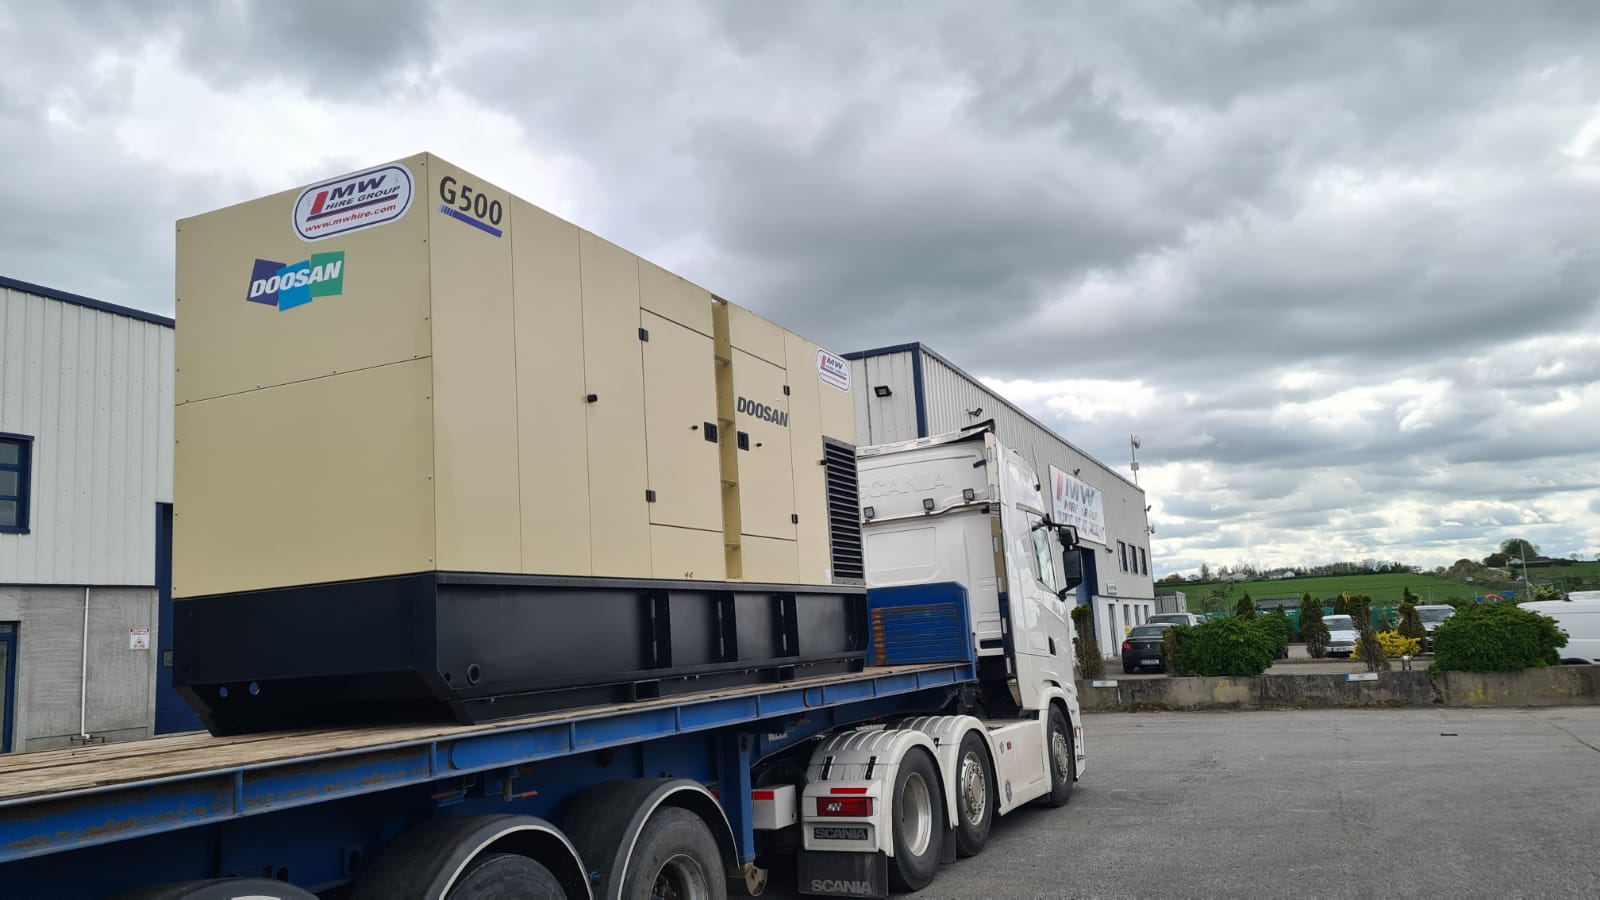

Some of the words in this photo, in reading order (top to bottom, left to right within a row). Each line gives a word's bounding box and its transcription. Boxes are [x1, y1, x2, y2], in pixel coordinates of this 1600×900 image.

[326, 197, 354, 210] HIRE
[357, 186, 400, 202] GROUP
[439, 176, 503, 226] G500
[305, 205, 397, 232] www.mwhire.com
[250, 260, 342, 298] DOOSAN
[737, 396, 788, 427] DOOSAN
[815, 828, 867, 840] SCANIA
[811, 880, 873, 894] SCANIA
